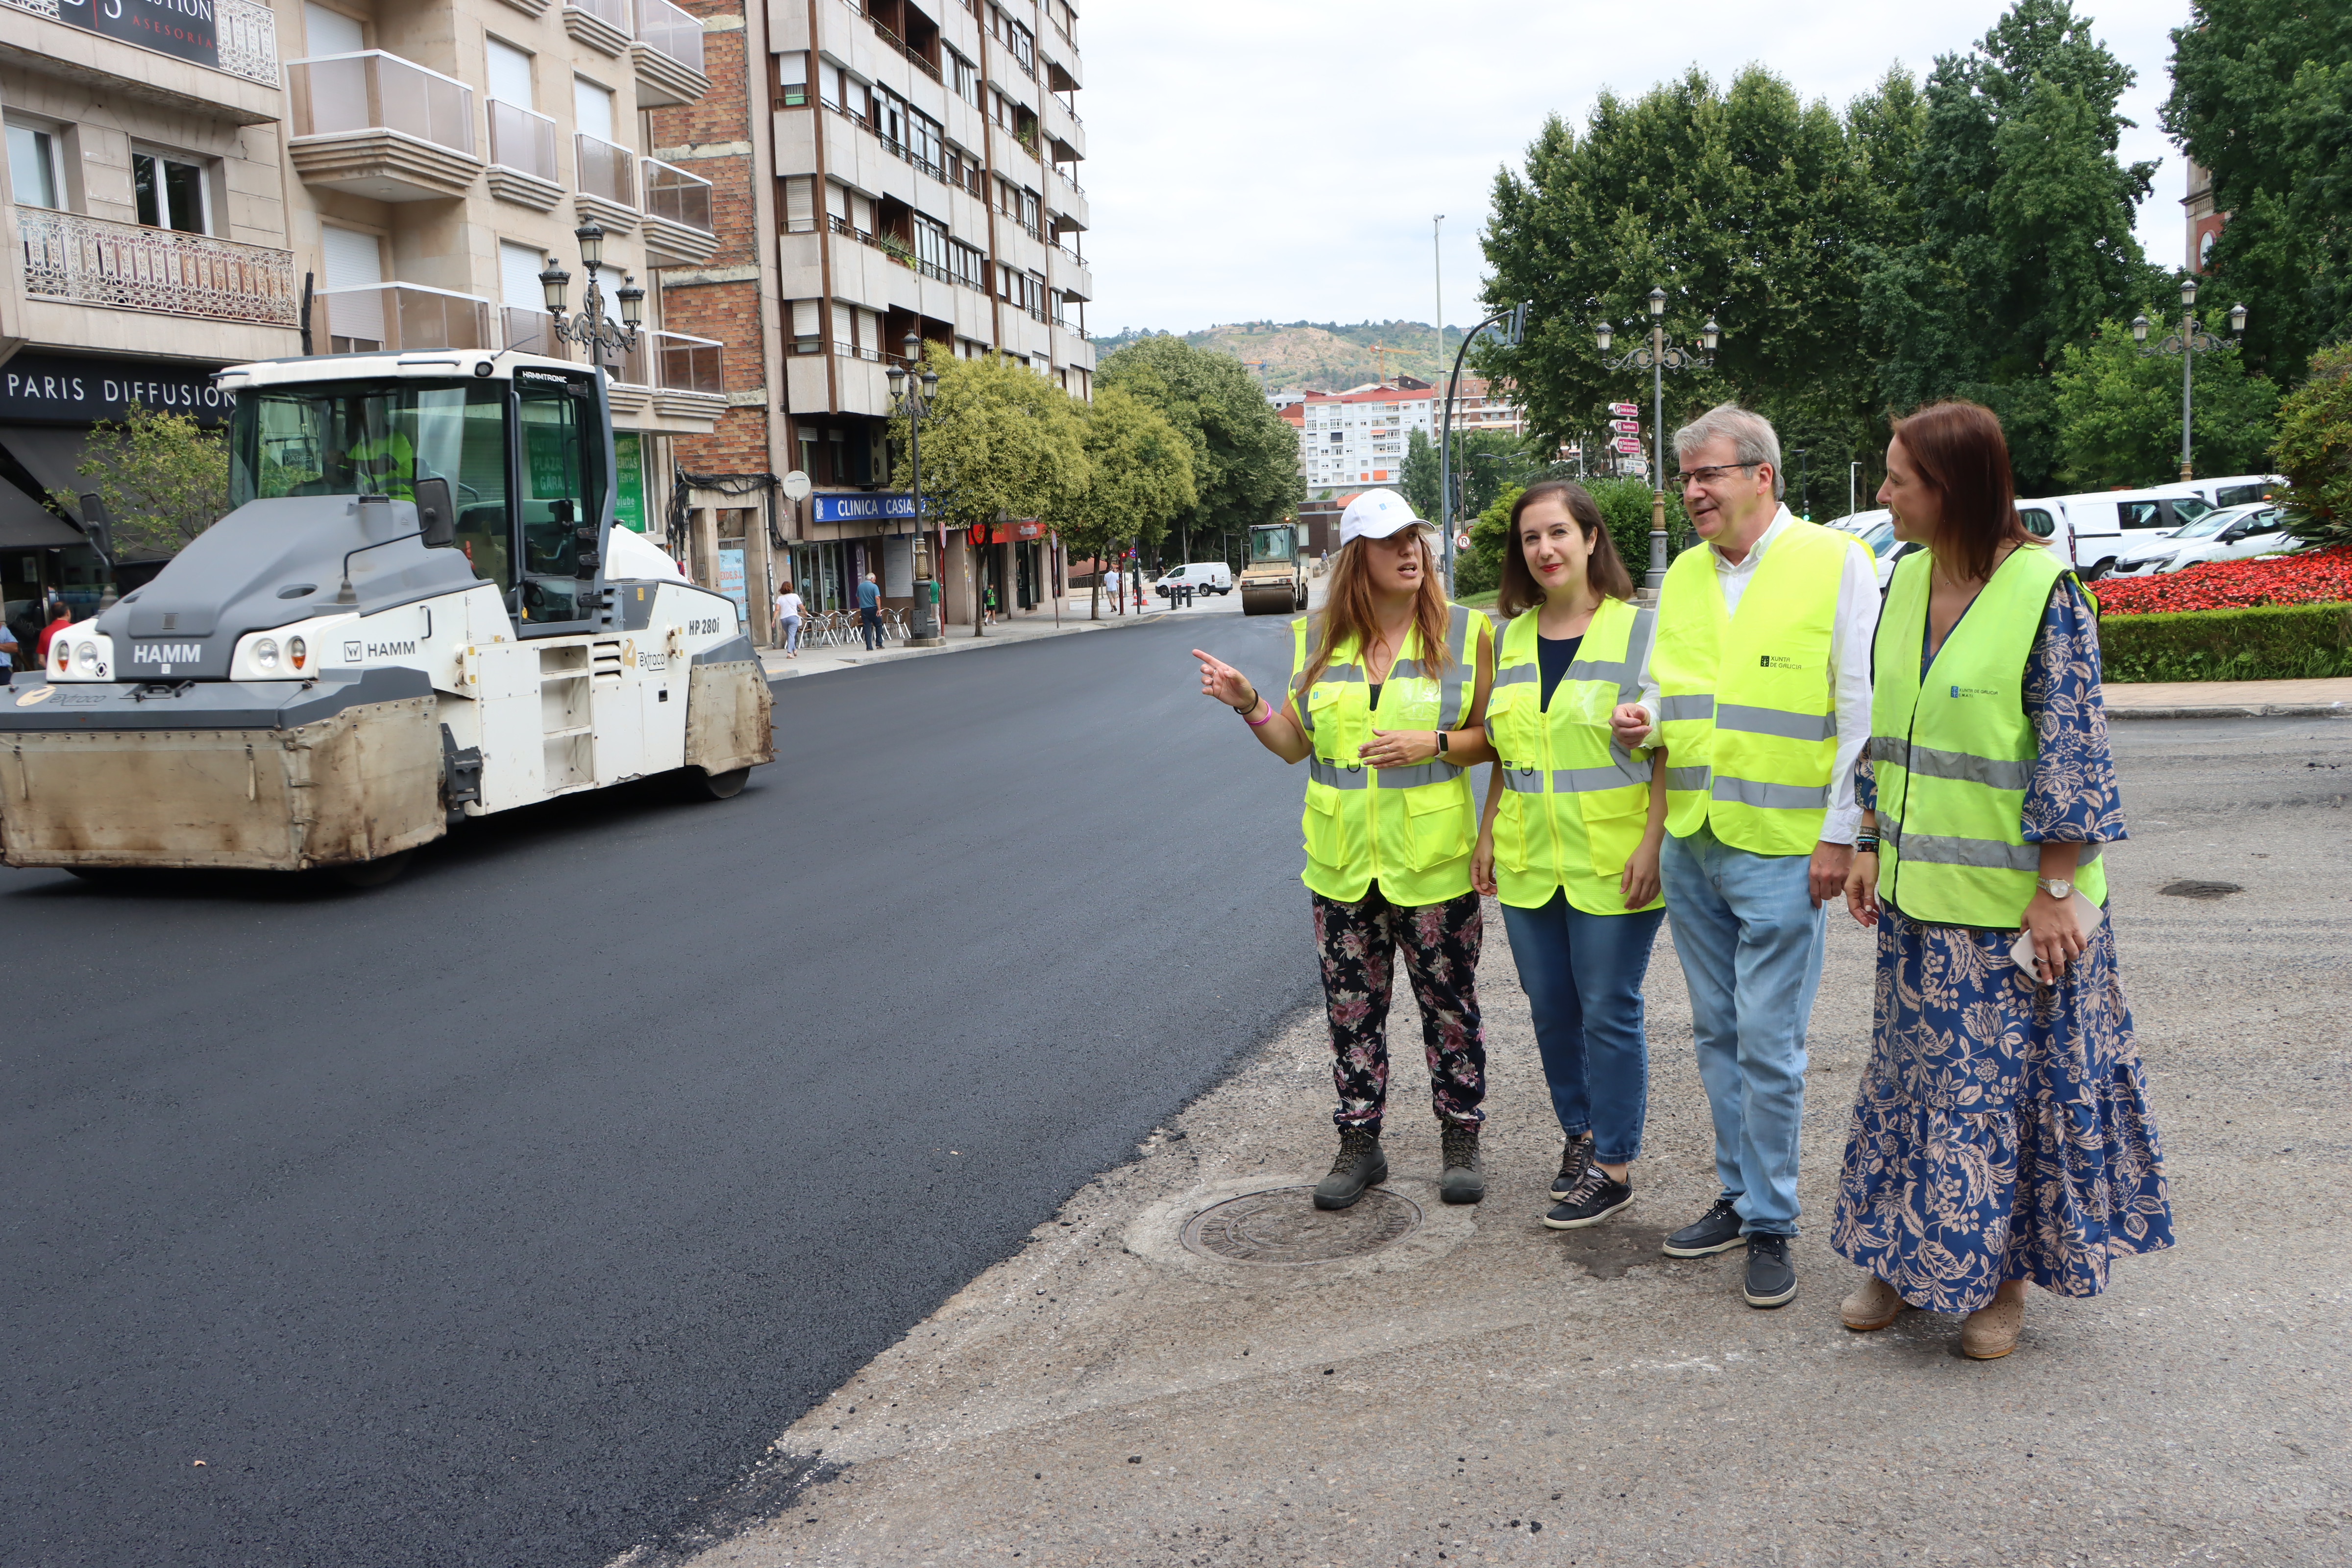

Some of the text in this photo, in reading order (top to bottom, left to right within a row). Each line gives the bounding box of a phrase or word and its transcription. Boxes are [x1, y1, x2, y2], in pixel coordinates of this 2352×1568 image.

[133, 15, 213, 49] ASESORÍA
[522, 370, 567, 384] HAMMTRONIC
[7, 373, 84, 401] PARIS
[837, 499, 878, 516] CLINICA
[689, 617, 719, 636] HP 280i
[133, 644, 201, 663] HAMM
[368, 641, 416, 657] HAMM
[637, 651, 665, 671] extraco
[50, 693, 107, 706] extraco
